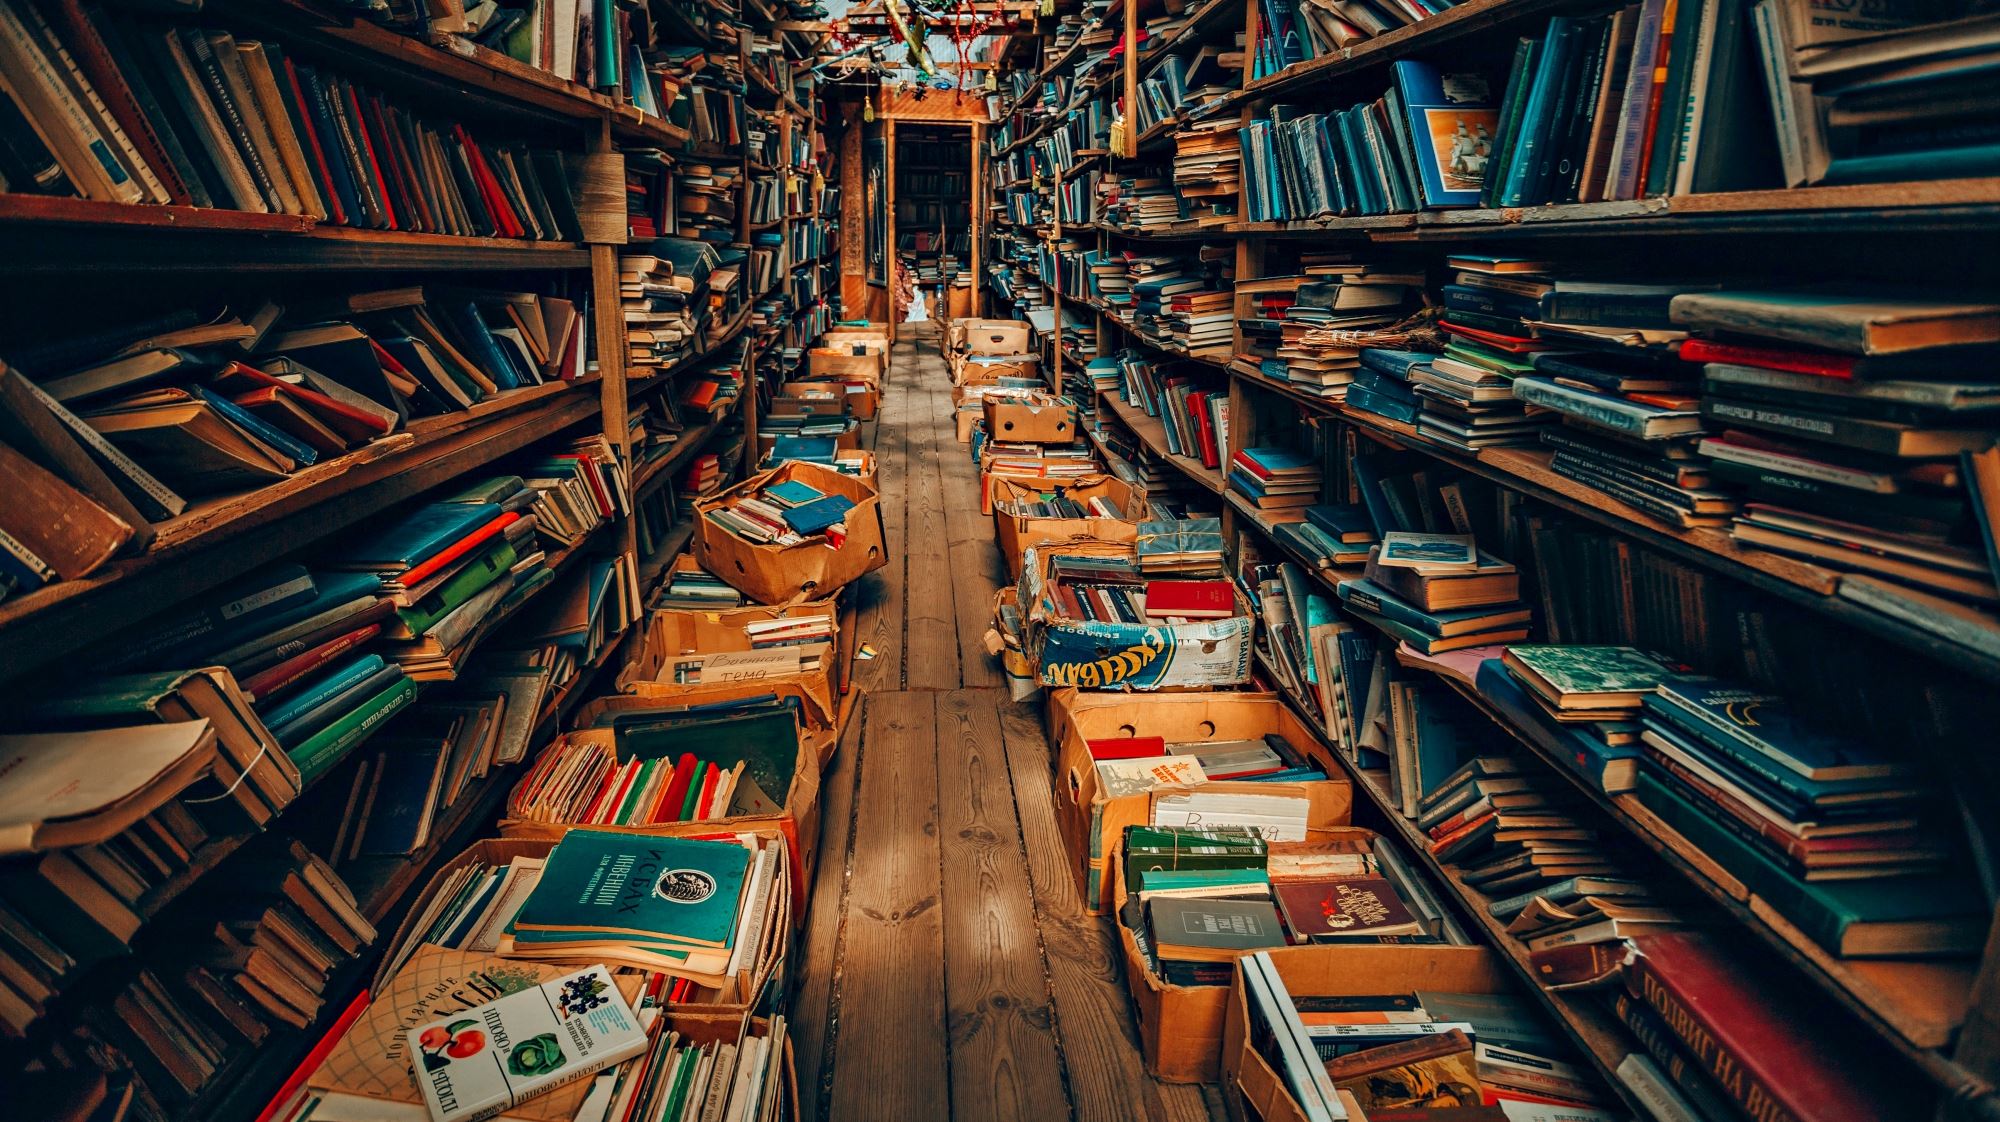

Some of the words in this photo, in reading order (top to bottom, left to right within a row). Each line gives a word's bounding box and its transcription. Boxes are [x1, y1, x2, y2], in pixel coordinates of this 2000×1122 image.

[1051, 624, 1120, 639] ECUADOR
[358, 693, 405, 731] СПРАВОЧНИК
[597, 852, 611, 867] ДЛЯ
[577, 866, 608, 905] ФОРТЕПИАНО
[593, 854, 637, 907] ИНВЕНЦИИ
[617, 876, 650, 915] БАХ
[386, 976, 458, 1060] ПОПУЛЯРНЫЕ
[564, 1020, 584, 1050] питании
[573, 1017, 593, 1049] человека
[1641, 969, 1716, 1063] ПОДВИГ
[1714, 1052, 1744, 1100] НА
[429, 1068, 459, 1115] ПЛОДЫ
[483, 1007, 508, 1049] ОВОЩИ
[566, 1060, 605, 1081] ПЛОДЫ
[516, 1080, 558, 1104] ОВОЩИ
